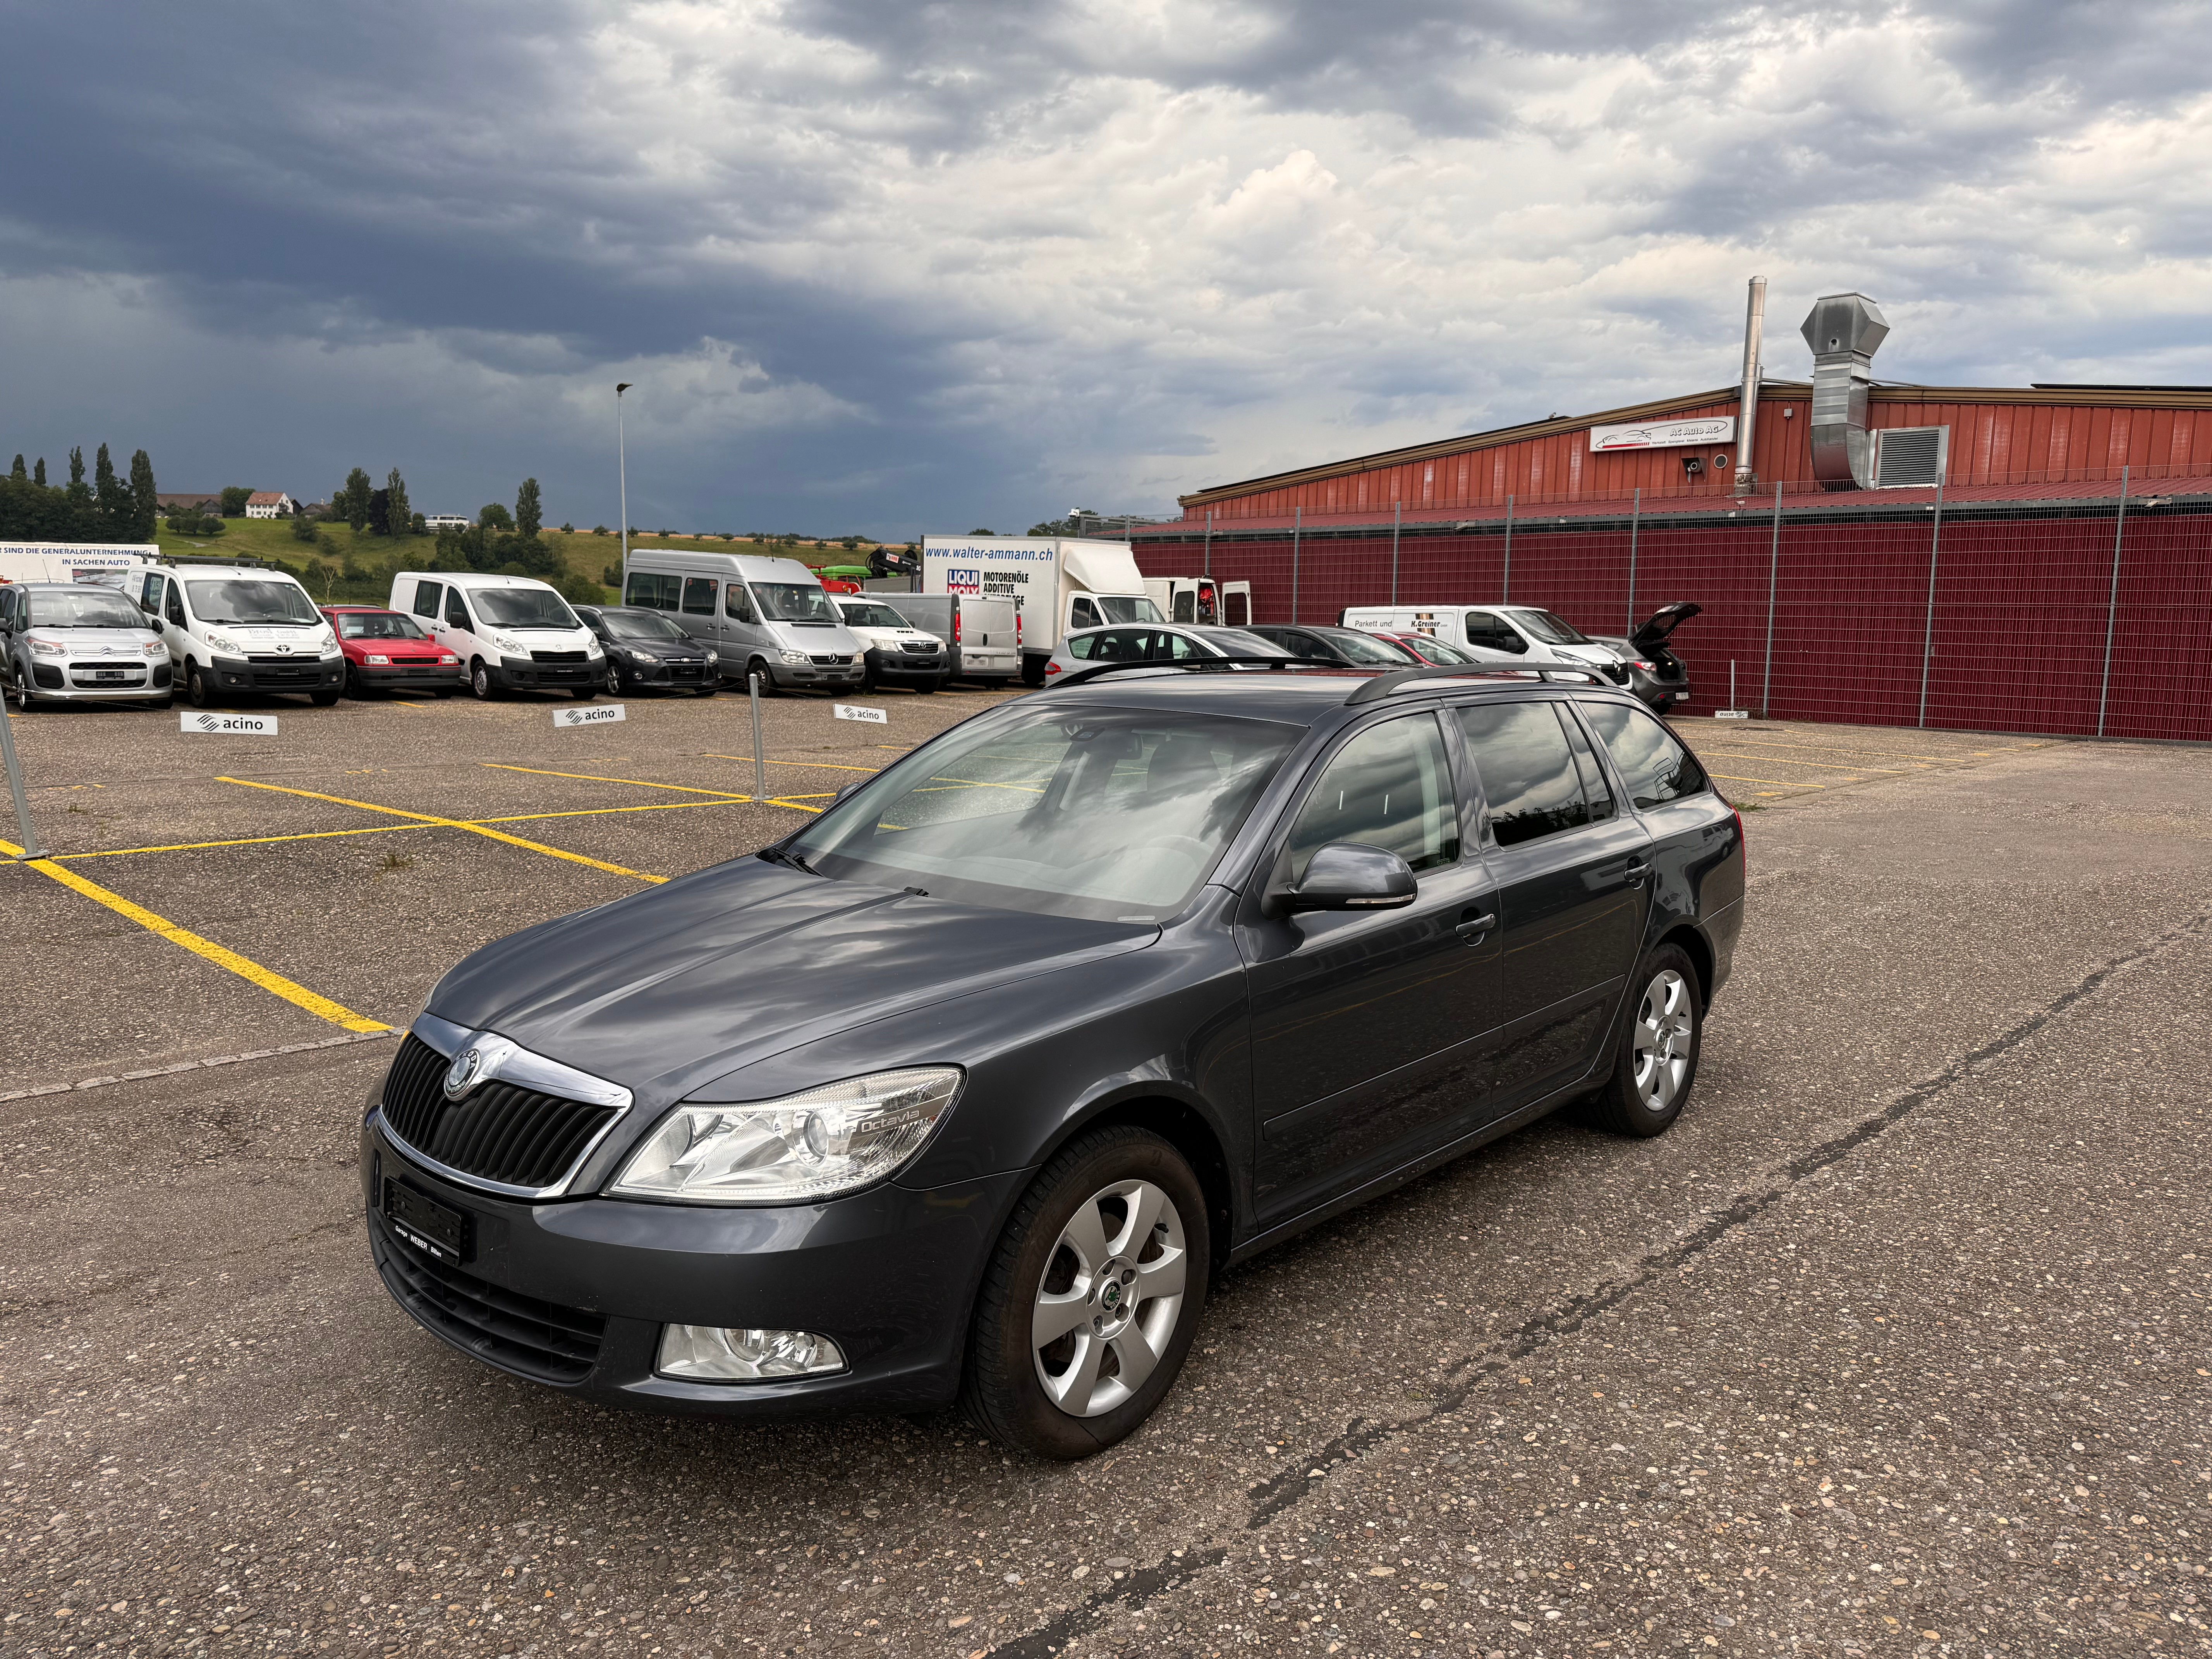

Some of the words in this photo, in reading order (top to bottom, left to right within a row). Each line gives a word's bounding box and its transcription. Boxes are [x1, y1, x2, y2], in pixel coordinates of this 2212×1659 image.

[1683, 427, 1704, 435] Auto
[1705, 426, 1719, 434] AG
[926, 546, 1053, 561] www.walter-ammann.ch
[949, 570, 979, 585] LIQUI
[984, 570, 1029, 584] MOTORENÖLE
[984, 582, 1015, 594] ADDITIVE
[585, 708, 615, 720] acino
[857, 709, 879, 720] acino
[223, 717, 263, 730] acino
[861, 1110, 919, 1133] Octavia
[395, 1225, 408, 1237] Garage
[410, 1234, 428, 1250] WEBER
